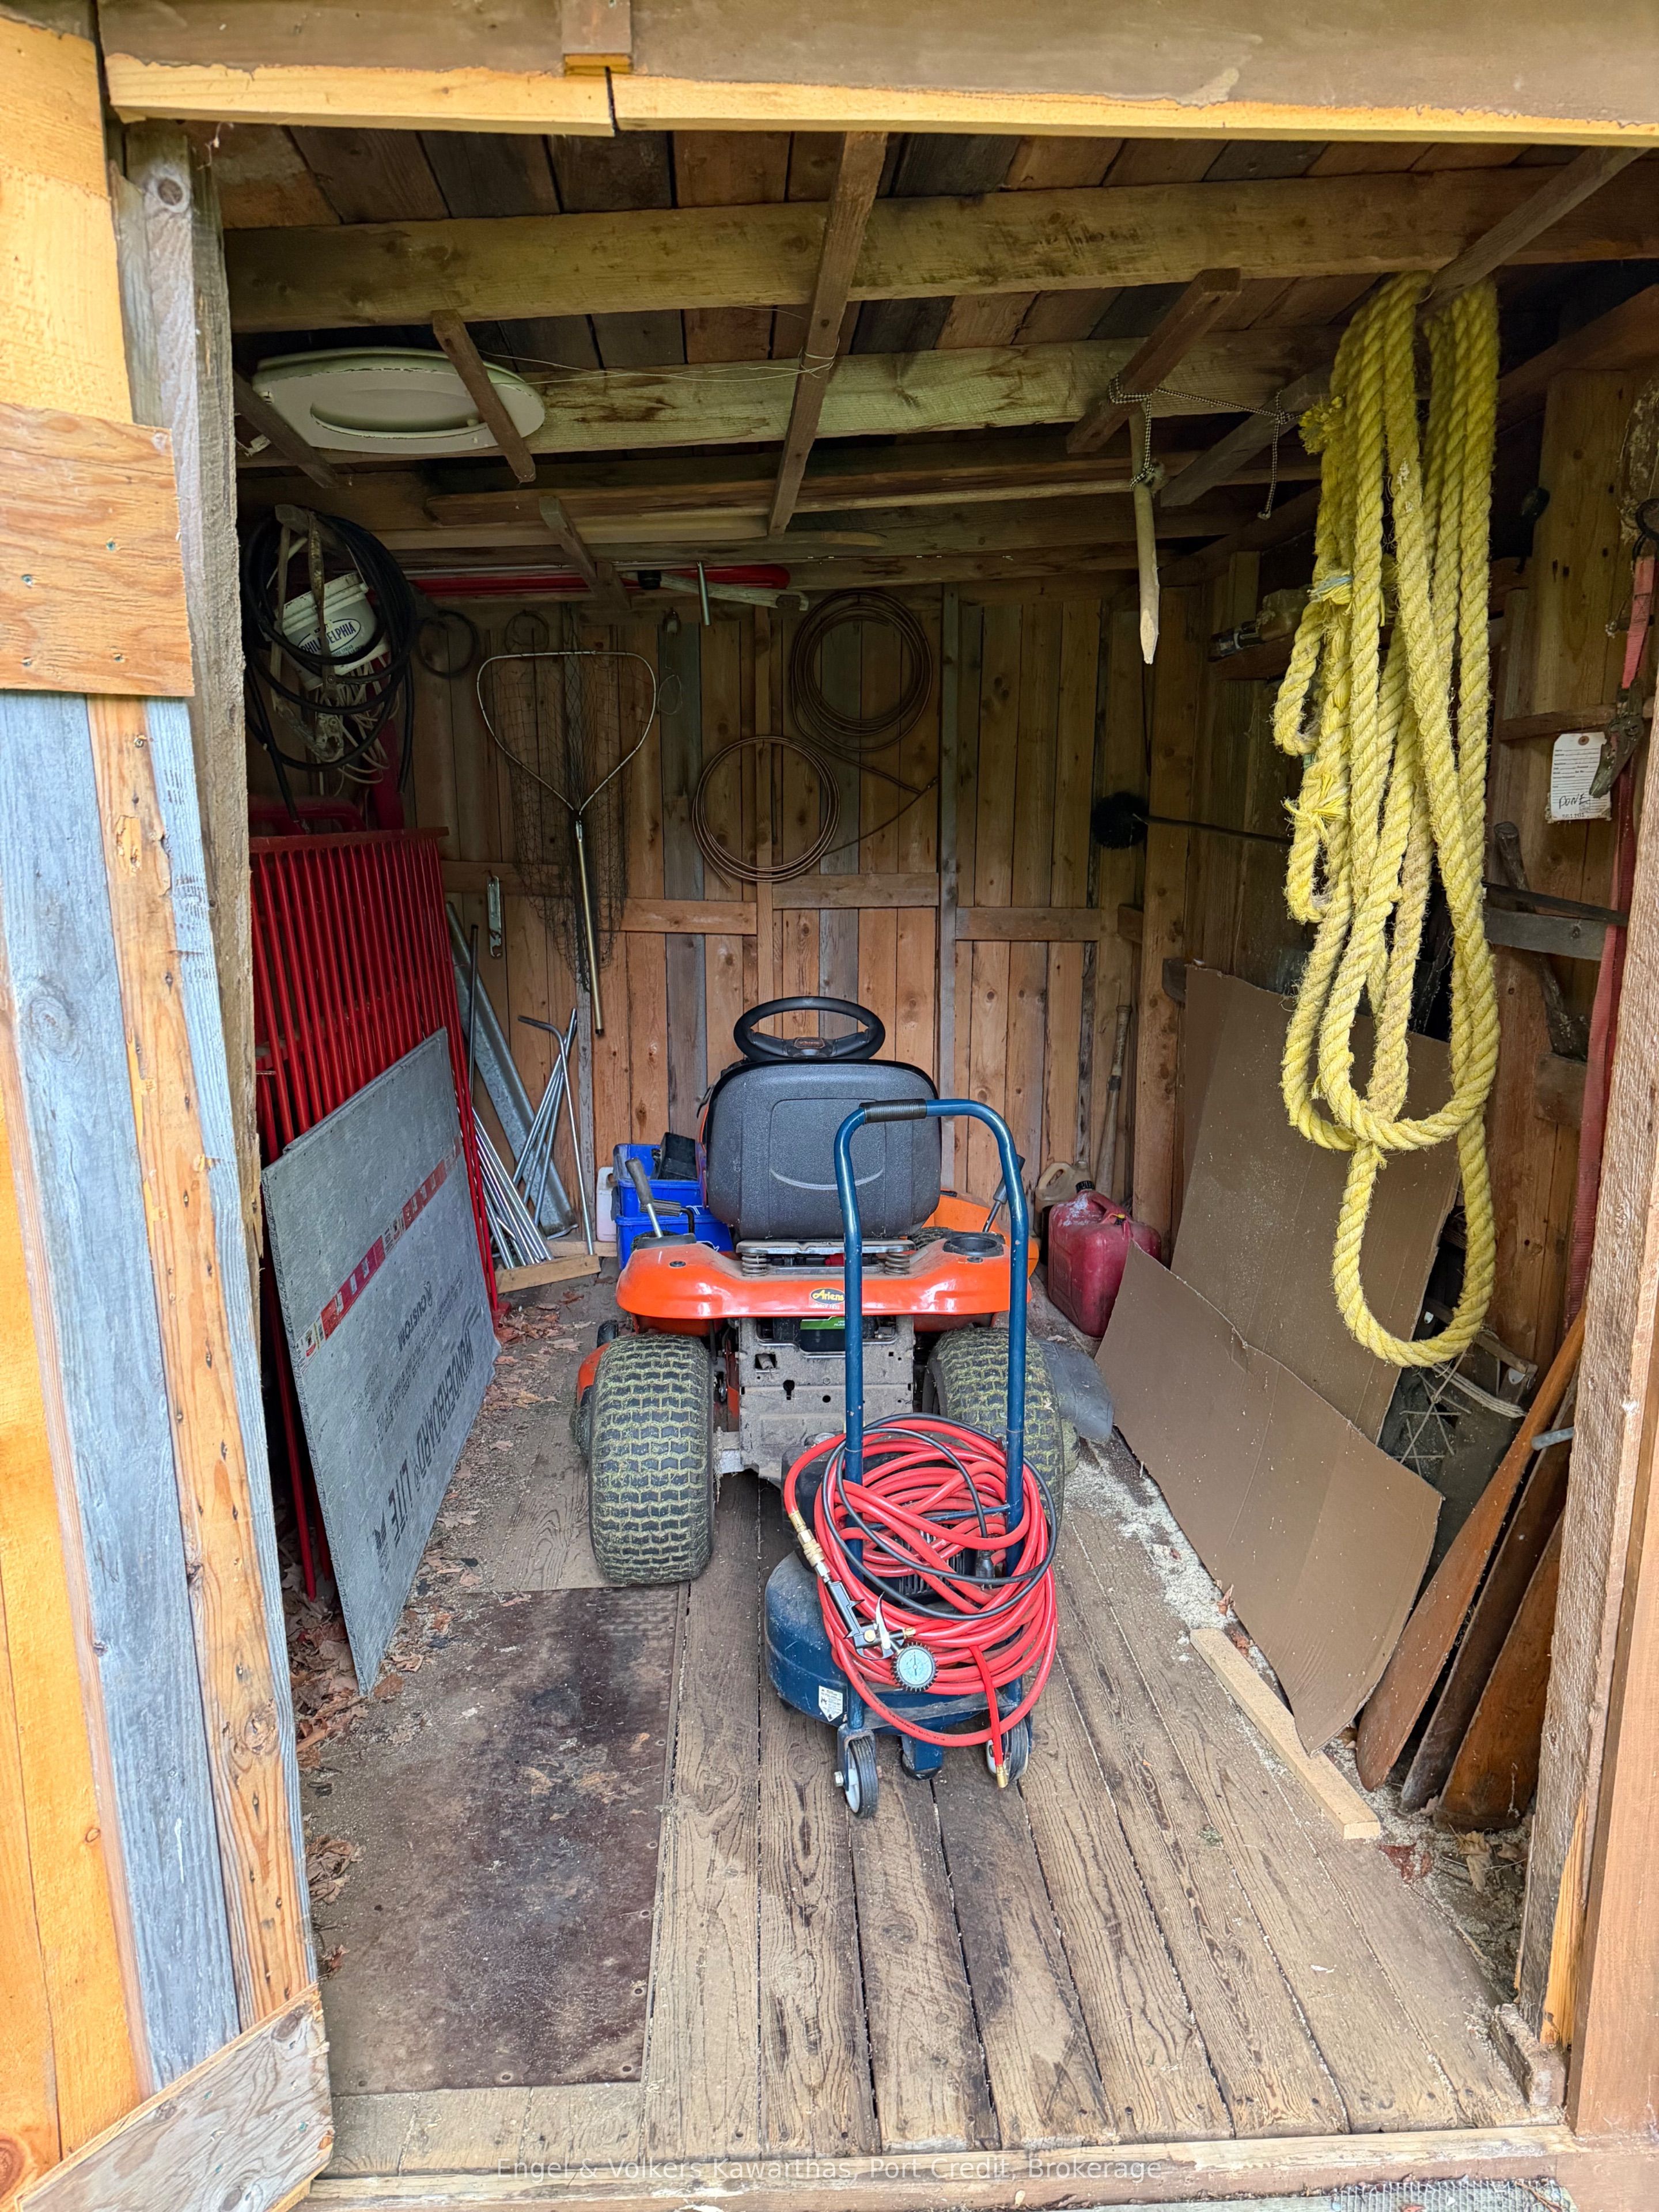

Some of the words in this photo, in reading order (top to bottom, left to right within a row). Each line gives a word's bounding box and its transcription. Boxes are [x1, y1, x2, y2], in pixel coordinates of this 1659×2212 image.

[300, 622, 356, 654] PHILELPHIA
[812, 1290, 844, 1301] Ariens
[397, 1294, 427, 1352] CUSTOM
[388, 1457, 413, 1548] LITE
